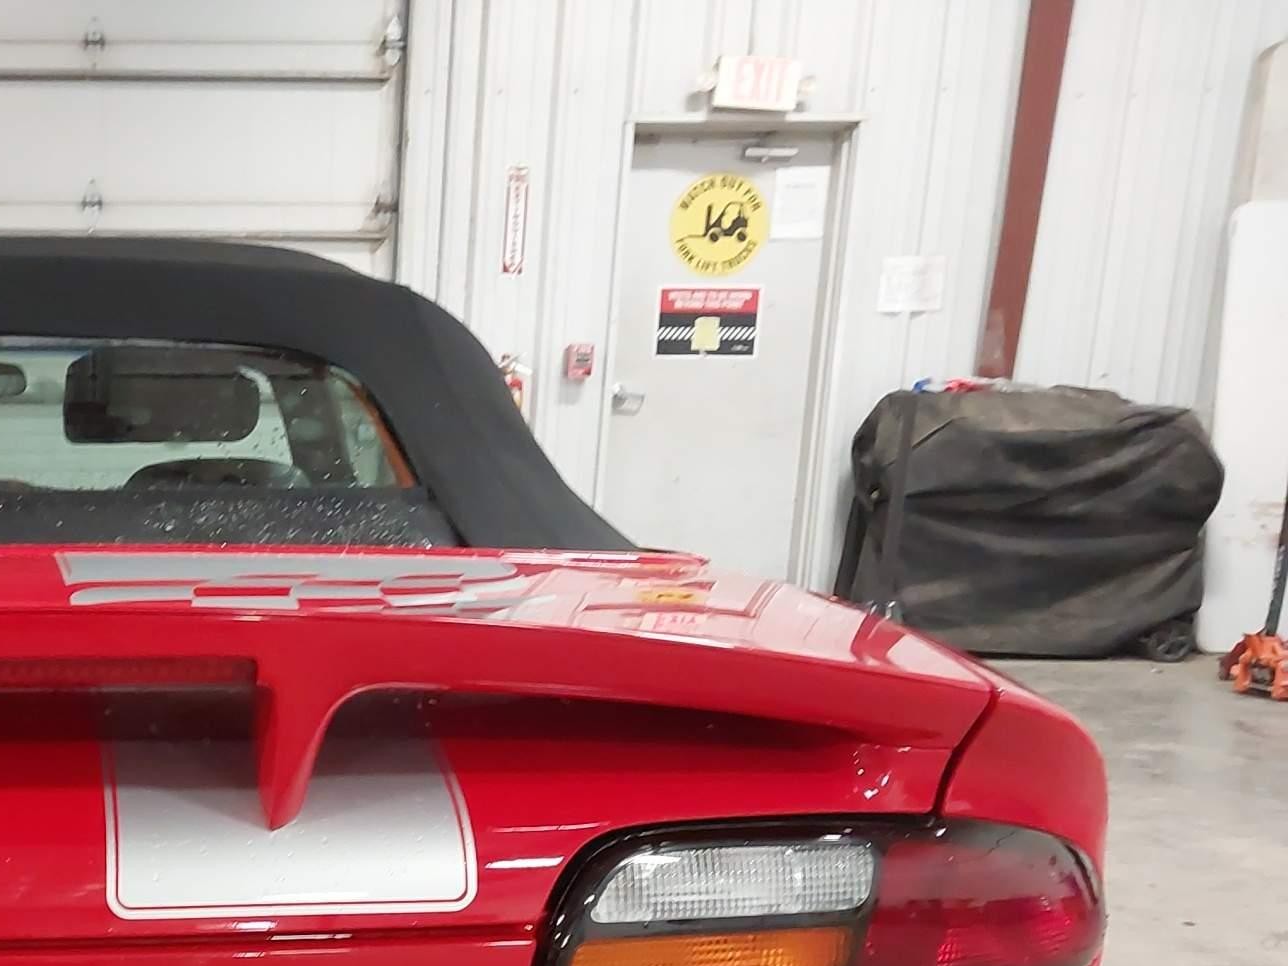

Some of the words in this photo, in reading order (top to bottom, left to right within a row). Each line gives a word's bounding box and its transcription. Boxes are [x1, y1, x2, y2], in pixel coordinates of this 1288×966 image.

[733, 57, 792, 103] EXIT
[720, 175, 743, 191] OUT
[743, 188, 761, 212] FOR
[695, 259, 718, 272] LIFT
